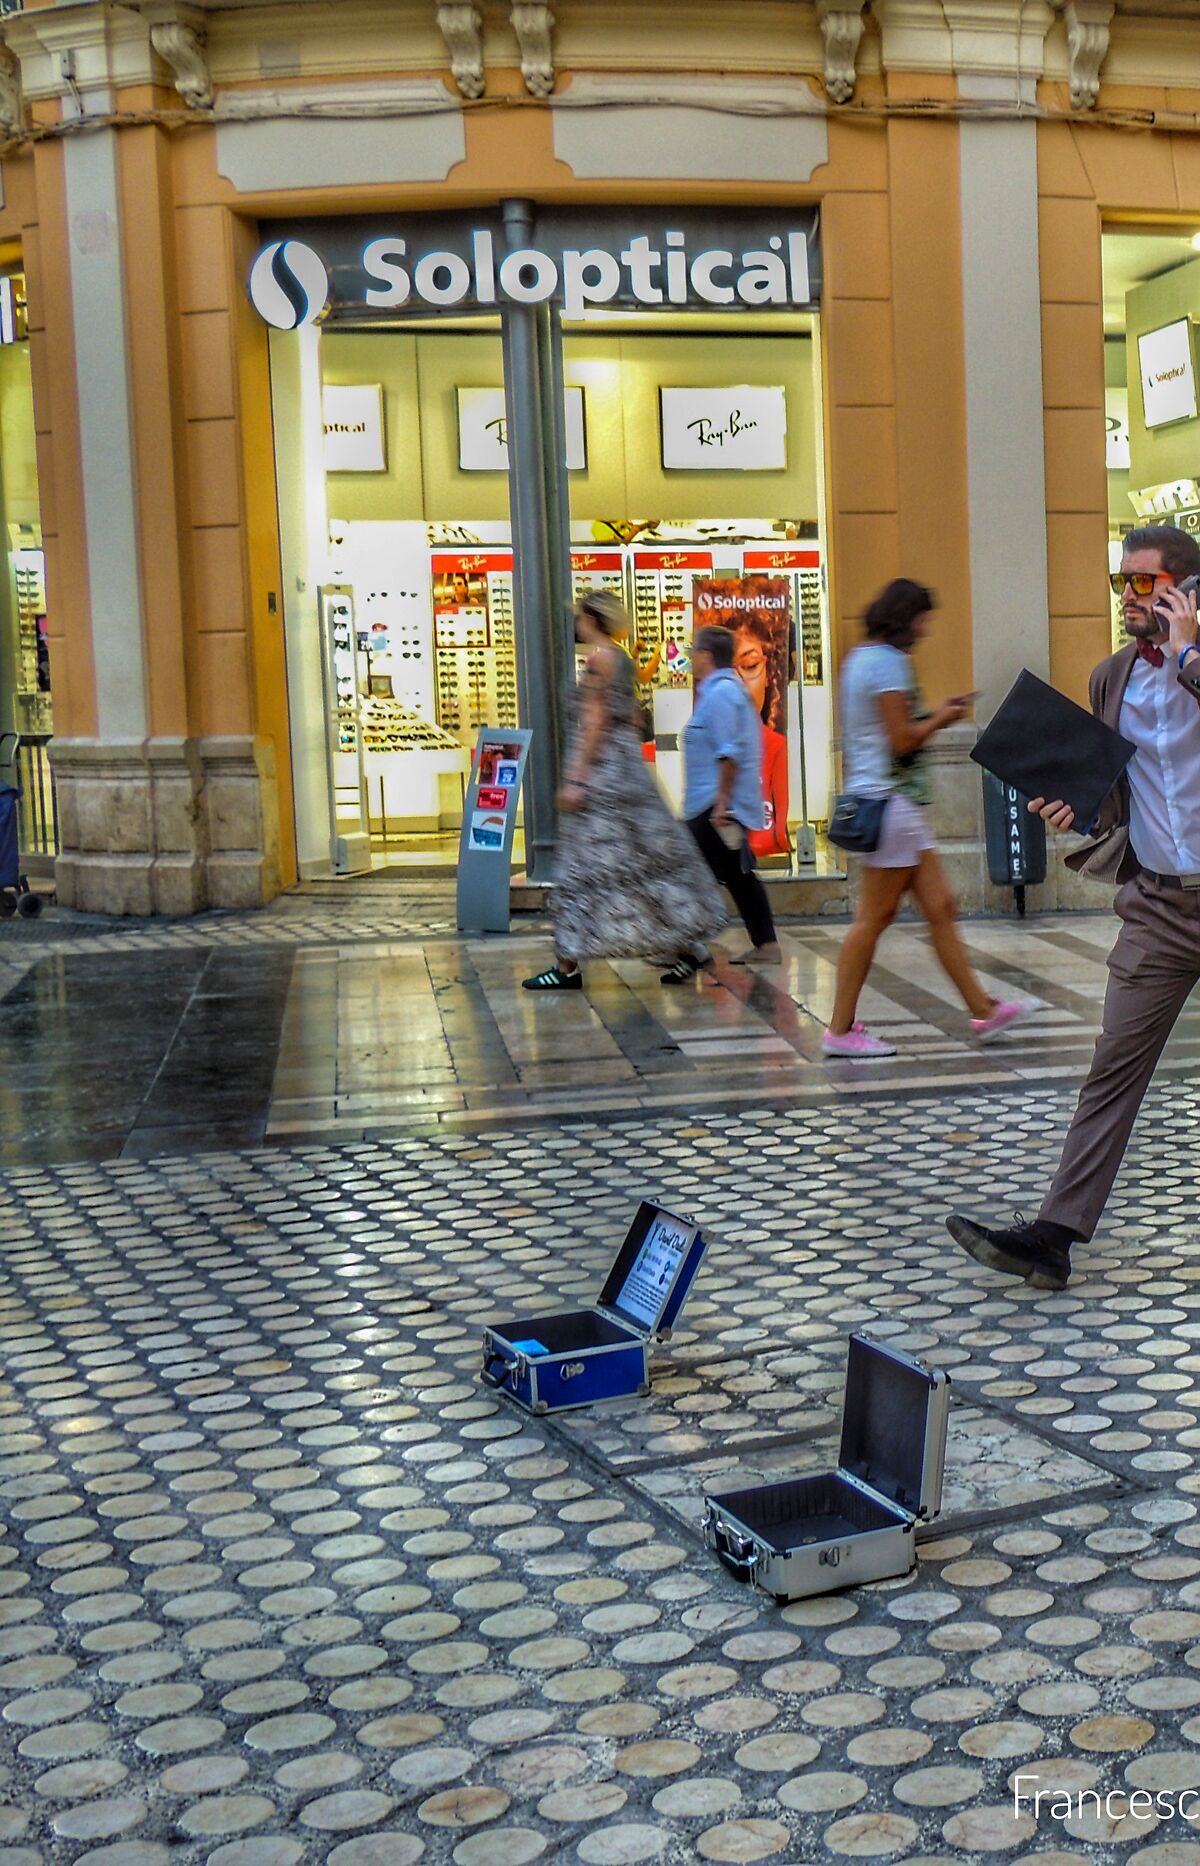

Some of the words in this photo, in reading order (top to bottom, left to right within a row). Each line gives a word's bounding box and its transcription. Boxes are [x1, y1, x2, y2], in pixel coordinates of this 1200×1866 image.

[362, 229, 810, 321] Soloptical
[687, 409, 757, 446] Ray-Ban
[713, 595, 785, 613] Soloptical
